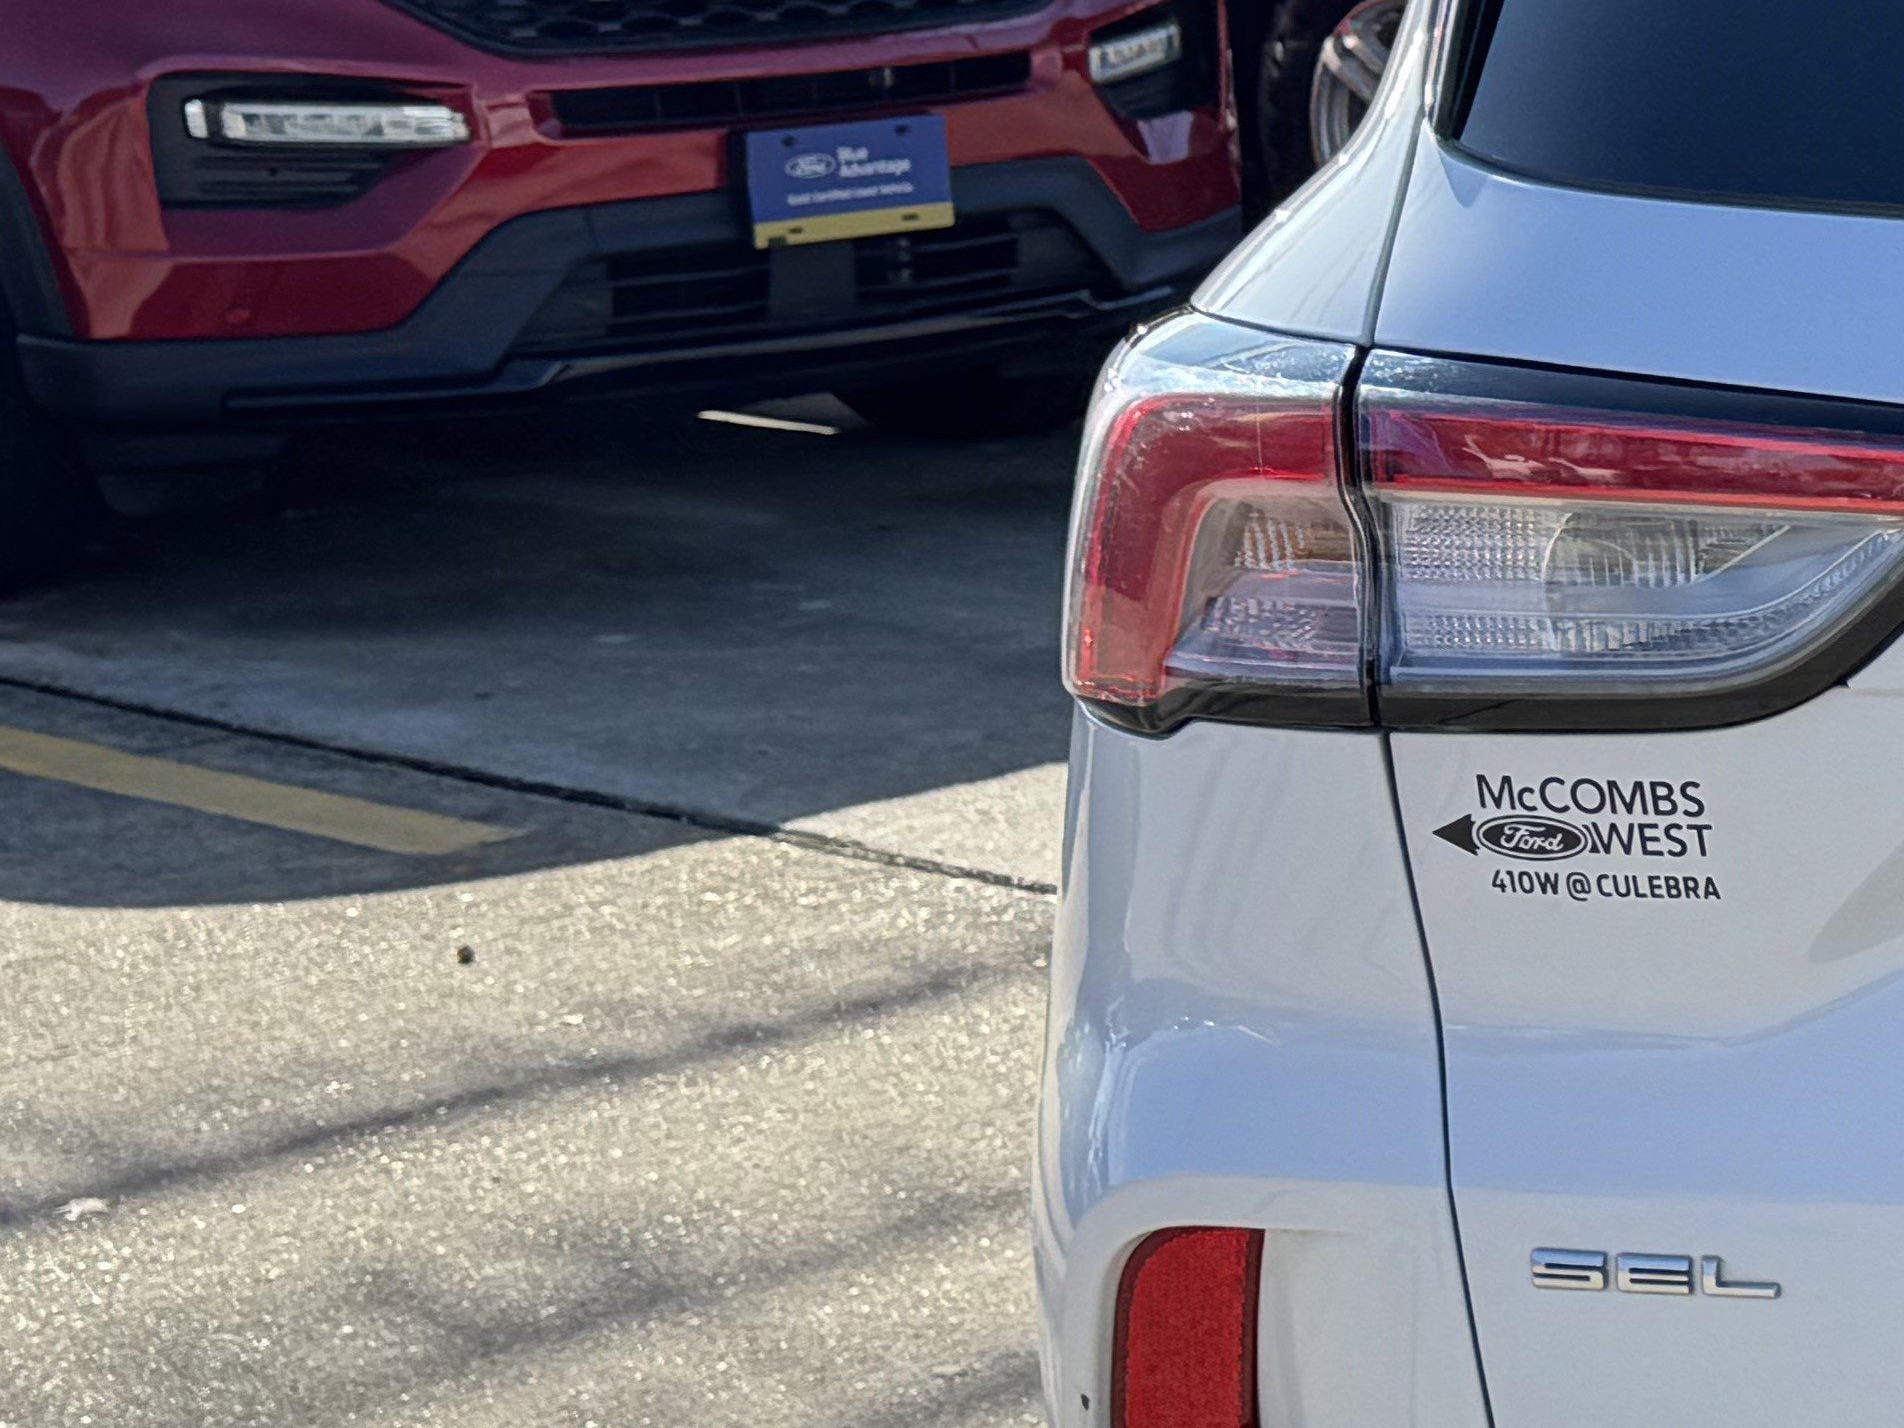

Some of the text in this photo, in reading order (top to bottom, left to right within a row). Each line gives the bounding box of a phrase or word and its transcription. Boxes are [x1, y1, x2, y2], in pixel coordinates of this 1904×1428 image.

[1475, 773, 1706, 818] McCOMBS
[1500, 823, 1564, 853] Ford
[1597, 822, 1713, 858] WEST
[1491, 869, 1722, 902] 410W @ CULEBRA
[1530, 1247, 1782, 1300] SEL
